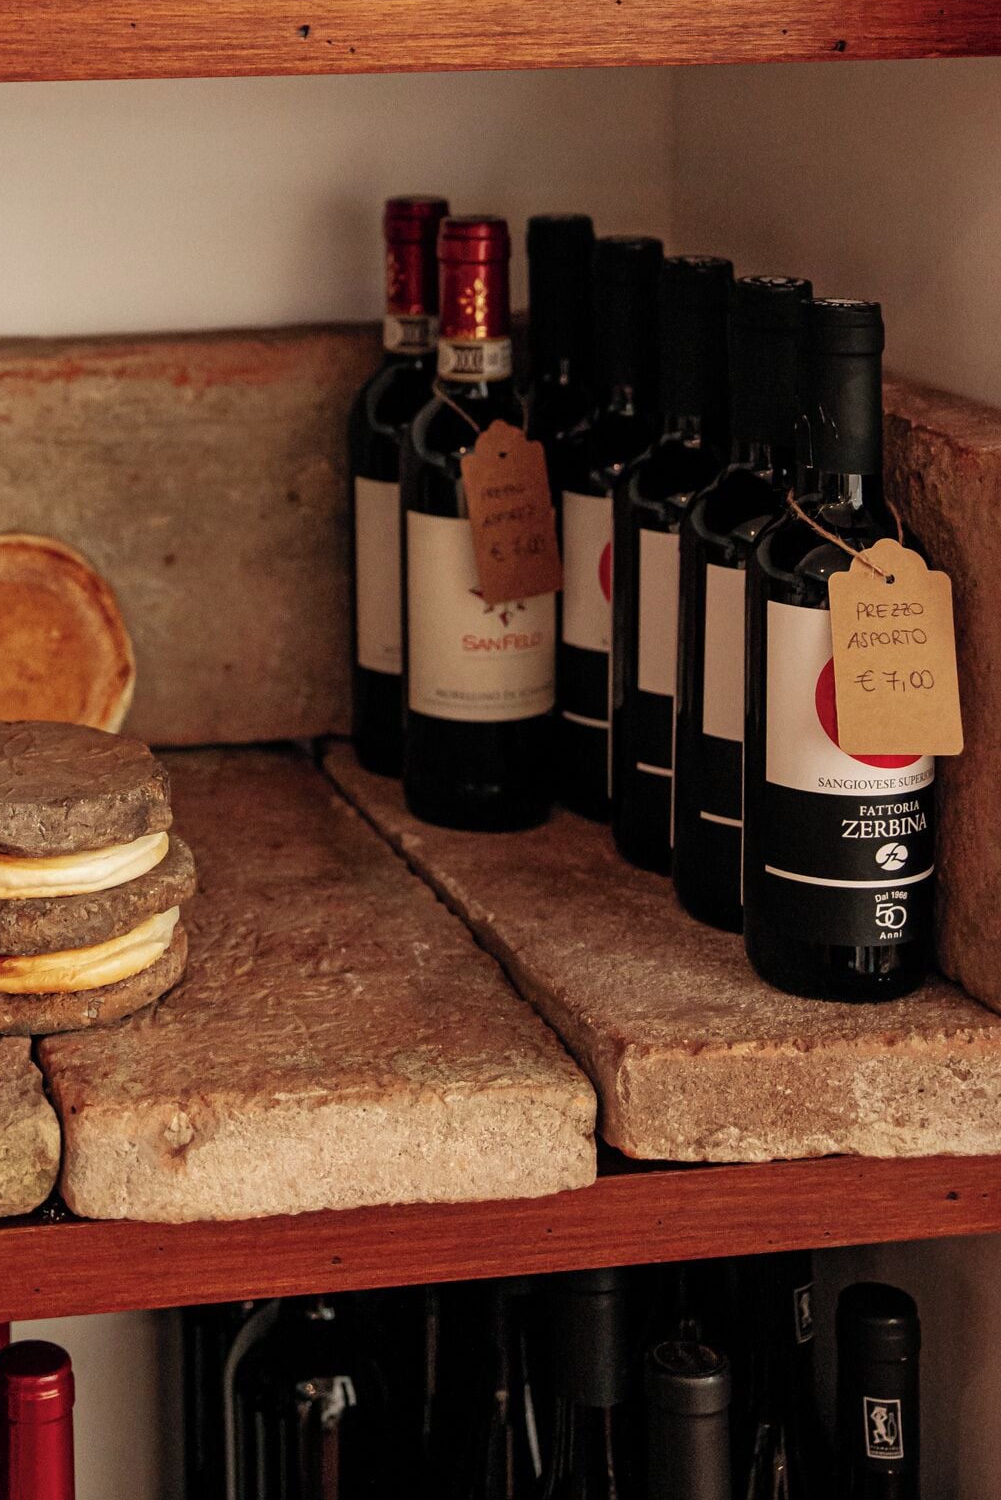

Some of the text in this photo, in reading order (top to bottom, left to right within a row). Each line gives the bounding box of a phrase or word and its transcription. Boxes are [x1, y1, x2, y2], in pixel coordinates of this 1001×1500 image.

[857, 602, 924, 620] PREZZO
[847, 628, 927, 649] ASPORTO
[854, 669, 934, 692] € 7,00
[818, 777, 896, 789] SANGIOVESE
[860, 800, 920, 816] FATTORIA
[841, 812, 927, 838] ZERBINA
[875, 892, 889, 903] Dal
[875, 903, 907, 929] 50
[880, 929, 902, 940] Anni
